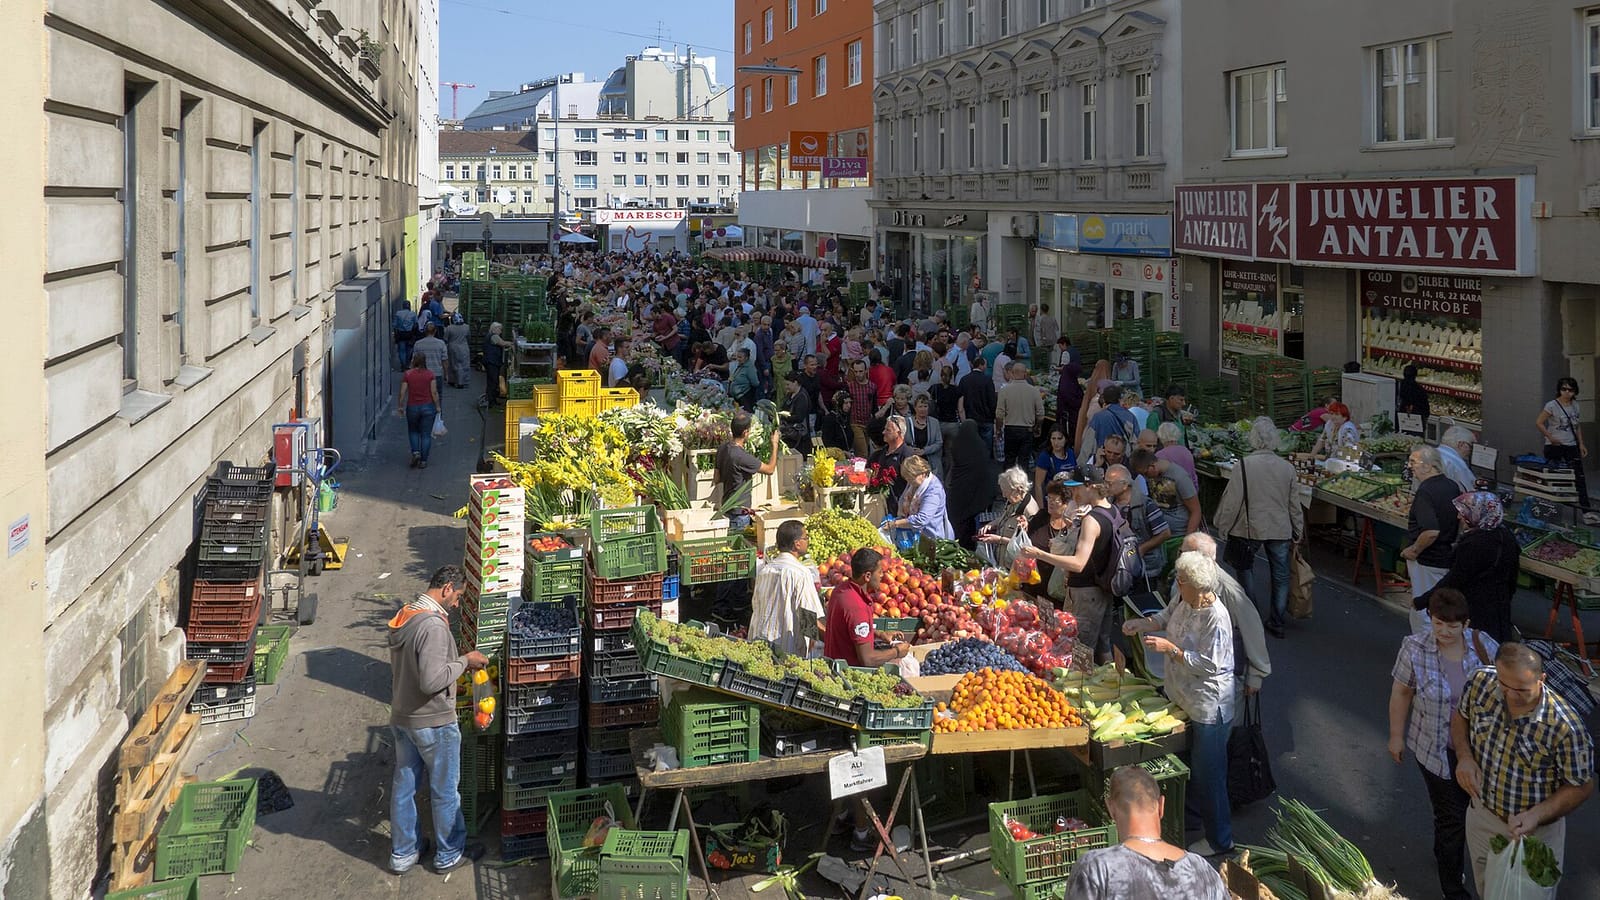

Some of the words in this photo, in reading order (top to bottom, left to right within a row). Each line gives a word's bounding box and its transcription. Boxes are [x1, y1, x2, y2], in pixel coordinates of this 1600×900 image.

[828, 158, 861, 169] Diva
[1180, 190, 1248, 222] JUWELIER
[1310, 186, 1500, 226] JUWELIER
[892, 211, 924, 226] Diva
[1183, 220, 1248, 249] ANTALYA
[1319, 225, 1499, 260] ANTALYA
[1171, 260, 1179, 300] BILLIG
[1368, 272, 1392, 282] GOLD
[1418, 276, 1450, 288] SILBER
[1448, 292, 1458, 300] 22
[1383, 296, 1470, 315] STICHPROBE
[730, 853, 755, 867] Joe's
